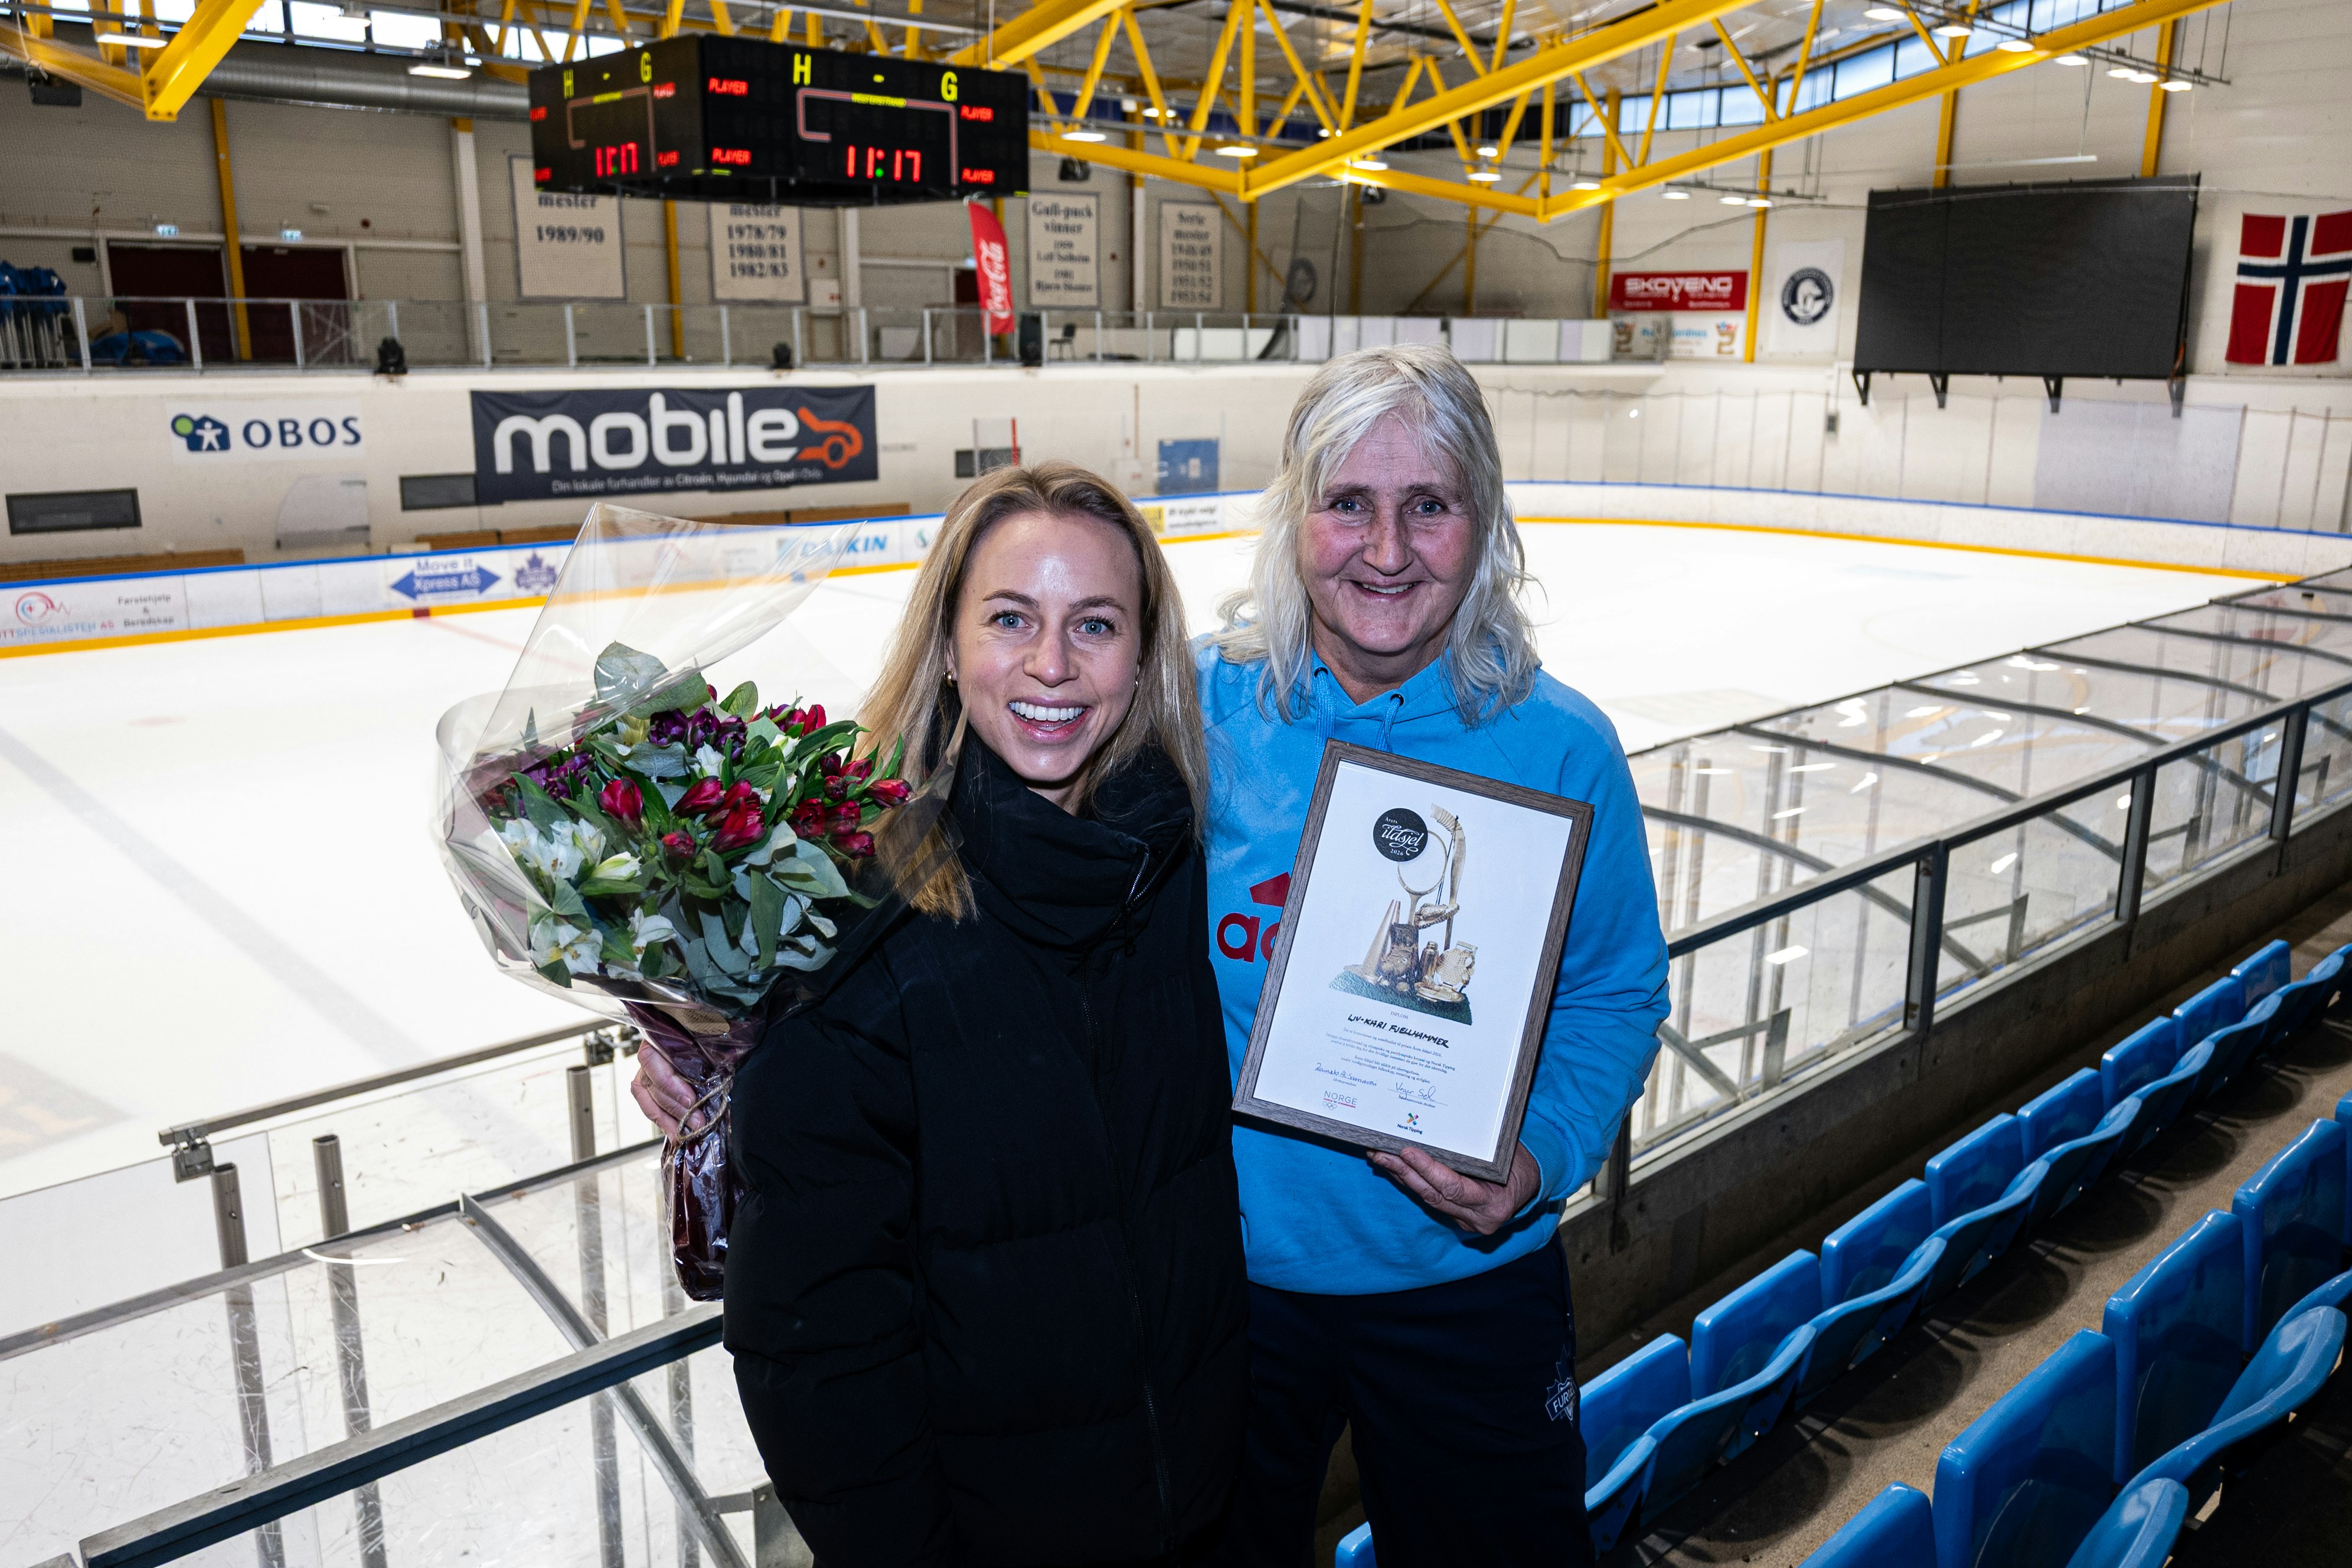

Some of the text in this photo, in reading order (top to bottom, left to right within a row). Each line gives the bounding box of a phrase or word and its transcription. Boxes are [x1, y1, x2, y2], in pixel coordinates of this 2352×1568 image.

[641, 52, 652, 83] G
[793, 53, 811, 85] H
[941, 71, 958, 102] G
[709, 77, 749, 97] PLAYER
[961, 105, 994, 122] PLAYER
[712, 148, 752, 165] PLAYER
[846, 145, 922, 182] 11:17
[962, 168, 995, 184] PLAYER
[243, 417, 361, 449] OBOS
[494, 391, 799, 473] mobile
[1390, 1011, 1409, 1020] DIPLOM
[1324, 1090, 1357, 1106] NORGE
